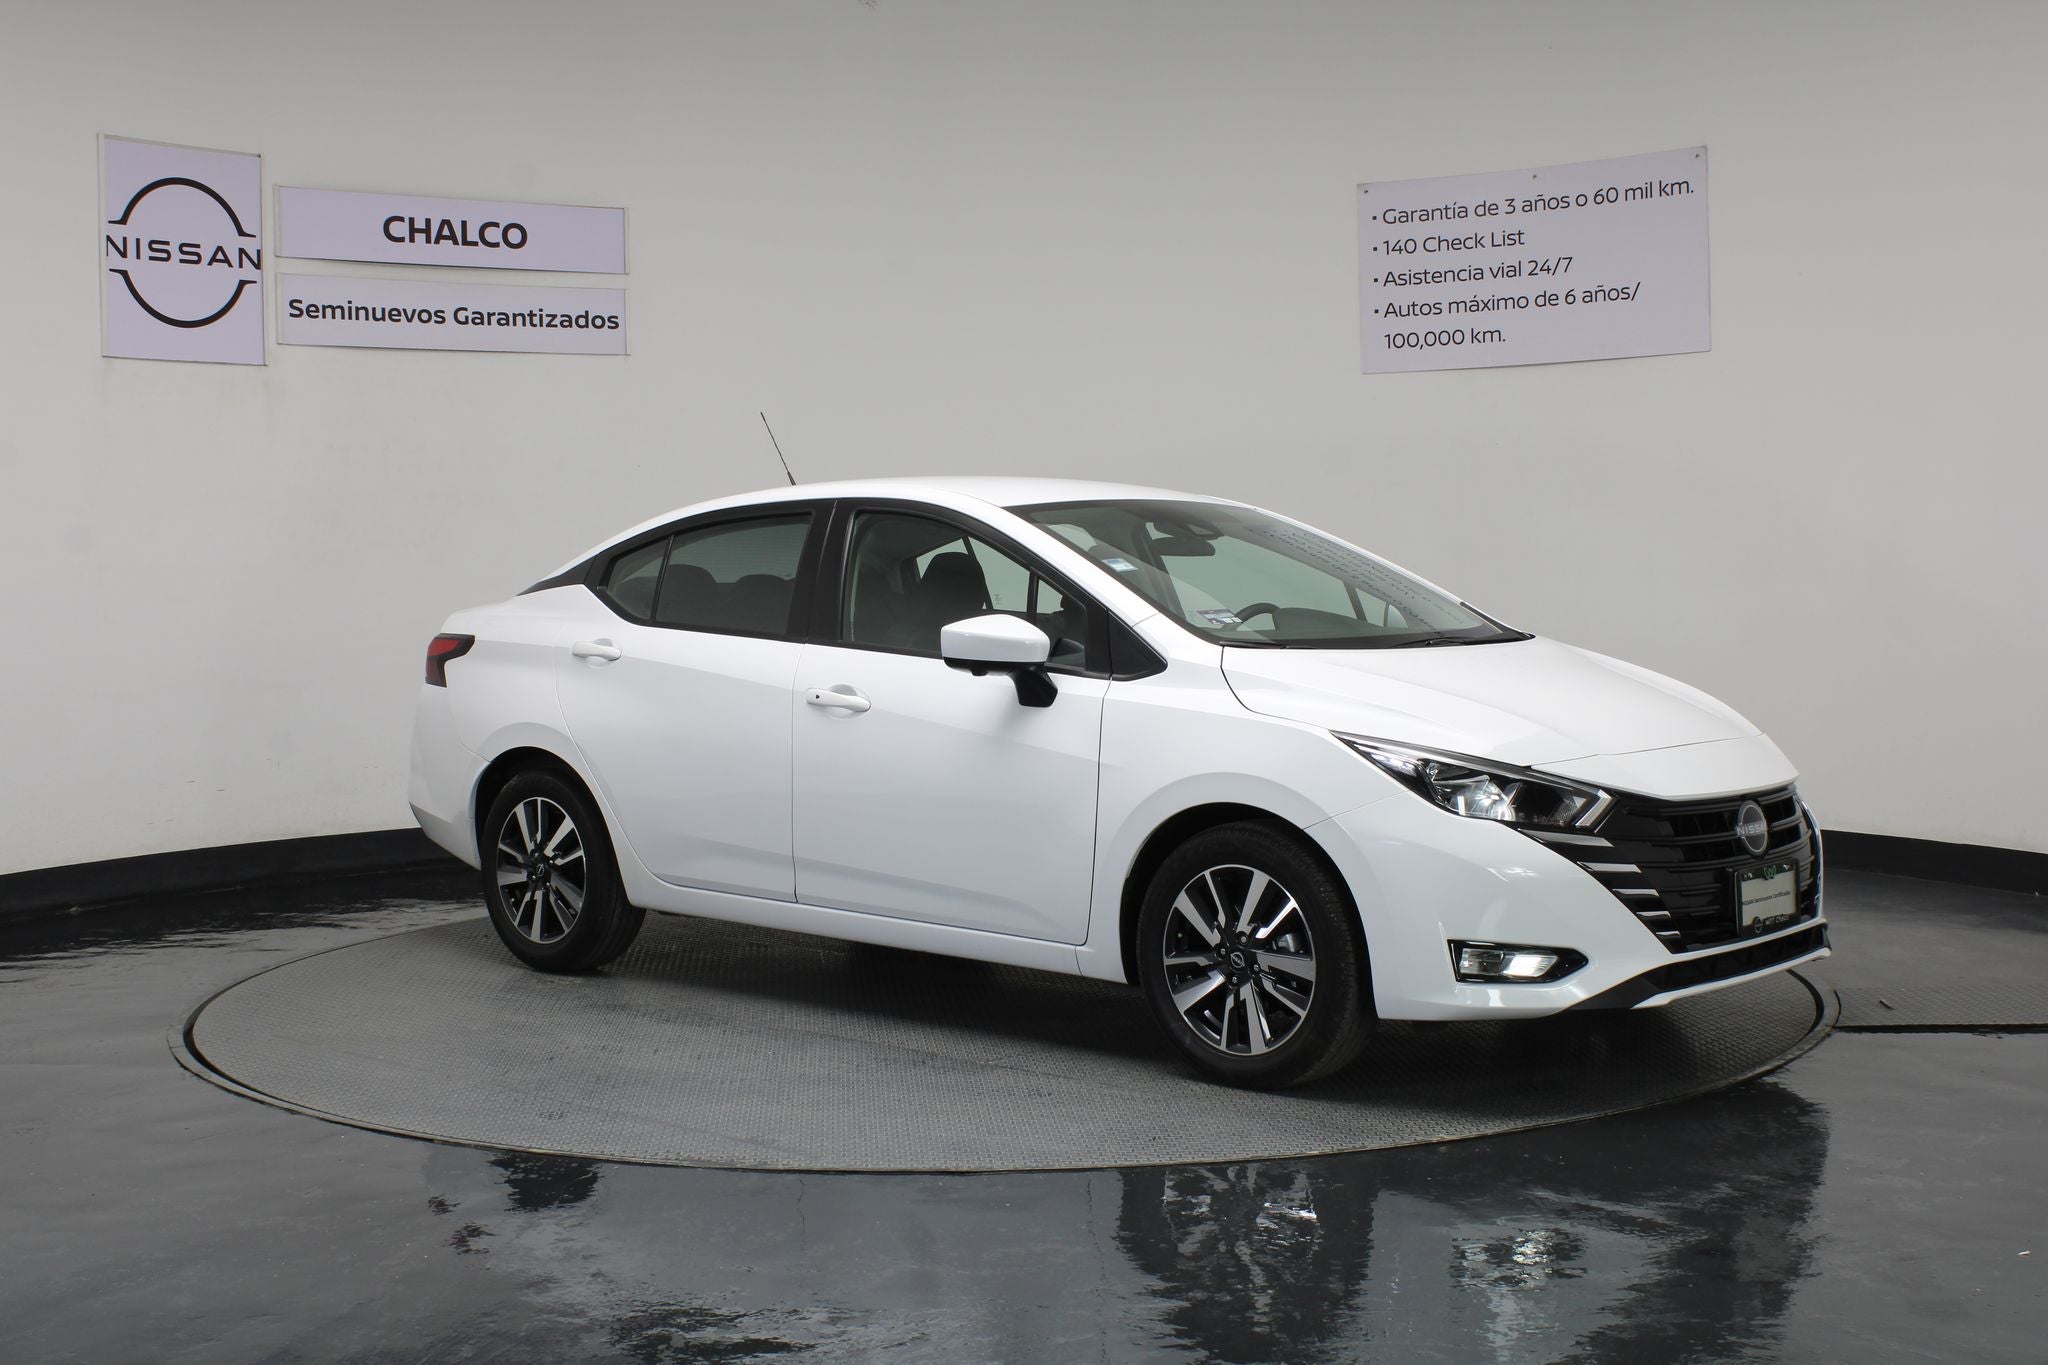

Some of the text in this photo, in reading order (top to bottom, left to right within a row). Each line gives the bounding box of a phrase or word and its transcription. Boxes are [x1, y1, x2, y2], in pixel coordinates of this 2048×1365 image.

[1382, 179, 1695, 225] Garantía de 3 años o 60 mil km.
[382, 215, 529, 250] CHALCO
[1382, 229, 1526, 256] 140 Check List
[106, 234, 261, 271] NISSAN
[1383, 256, 1574, 288] Asistencia vial 24/7
[288, 298, 621, 330] Seminuevos Garantizados
[1383, 281, 1642, 319] Autos máximo de 6 años/
[1383, 327, 1507, 351] 100,000 km.
